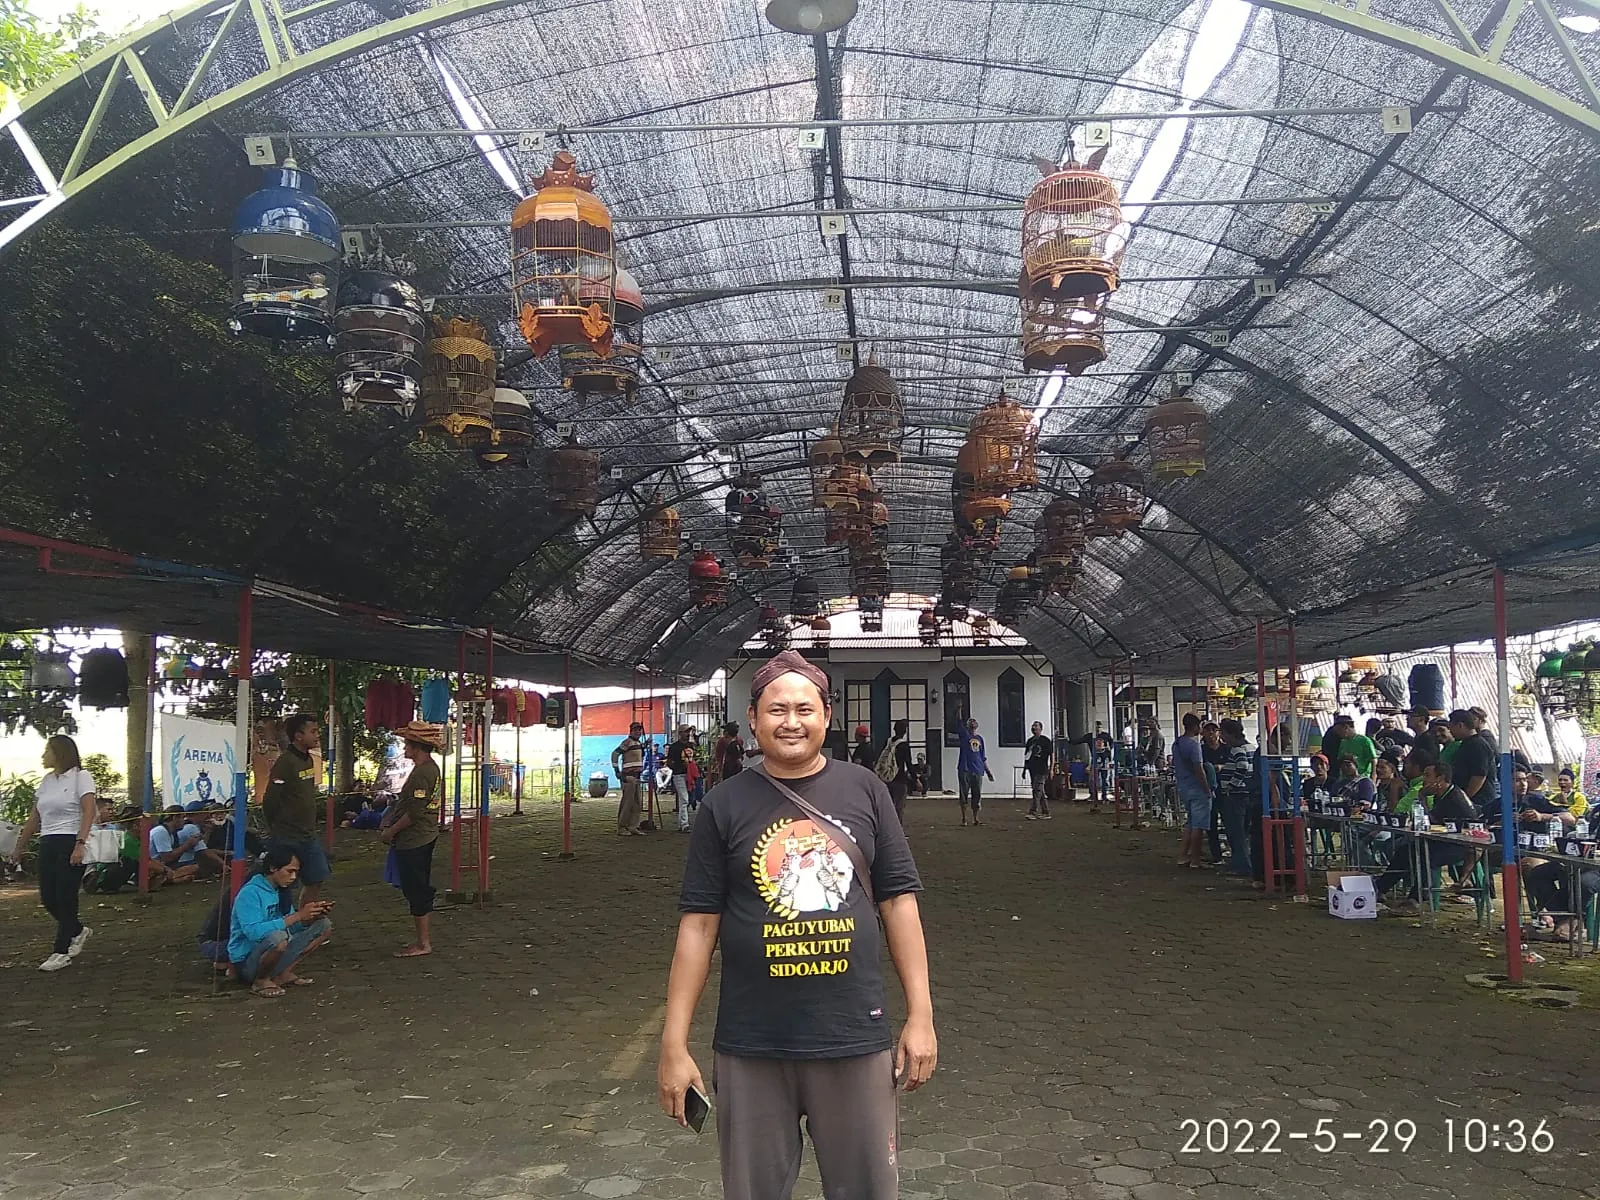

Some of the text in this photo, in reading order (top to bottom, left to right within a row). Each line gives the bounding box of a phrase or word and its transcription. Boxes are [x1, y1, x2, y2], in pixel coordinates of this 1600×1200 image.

[1392, 114, 1401, 125] 1
[806, 132, 815, 143] 3
[1094, 128, 1103, 140] 2
[256, 146, 265, 157] 5
[829, 220, 837, 230] 8
[349, 237, 357, 247] 6
[826, 295, 840, 304] 13
[1213, 335, 1227, 343] 20
[659, 351, 671, 359] 17
[840, 348, 851, 356] 18
[184, 749, 223, 764] AREMA
[763, 918, 854, 938] PAGUYUBAN
[766, 939, 851, 957] PERKUTUT
[770, 959, 848, 976] SIDOARJO
